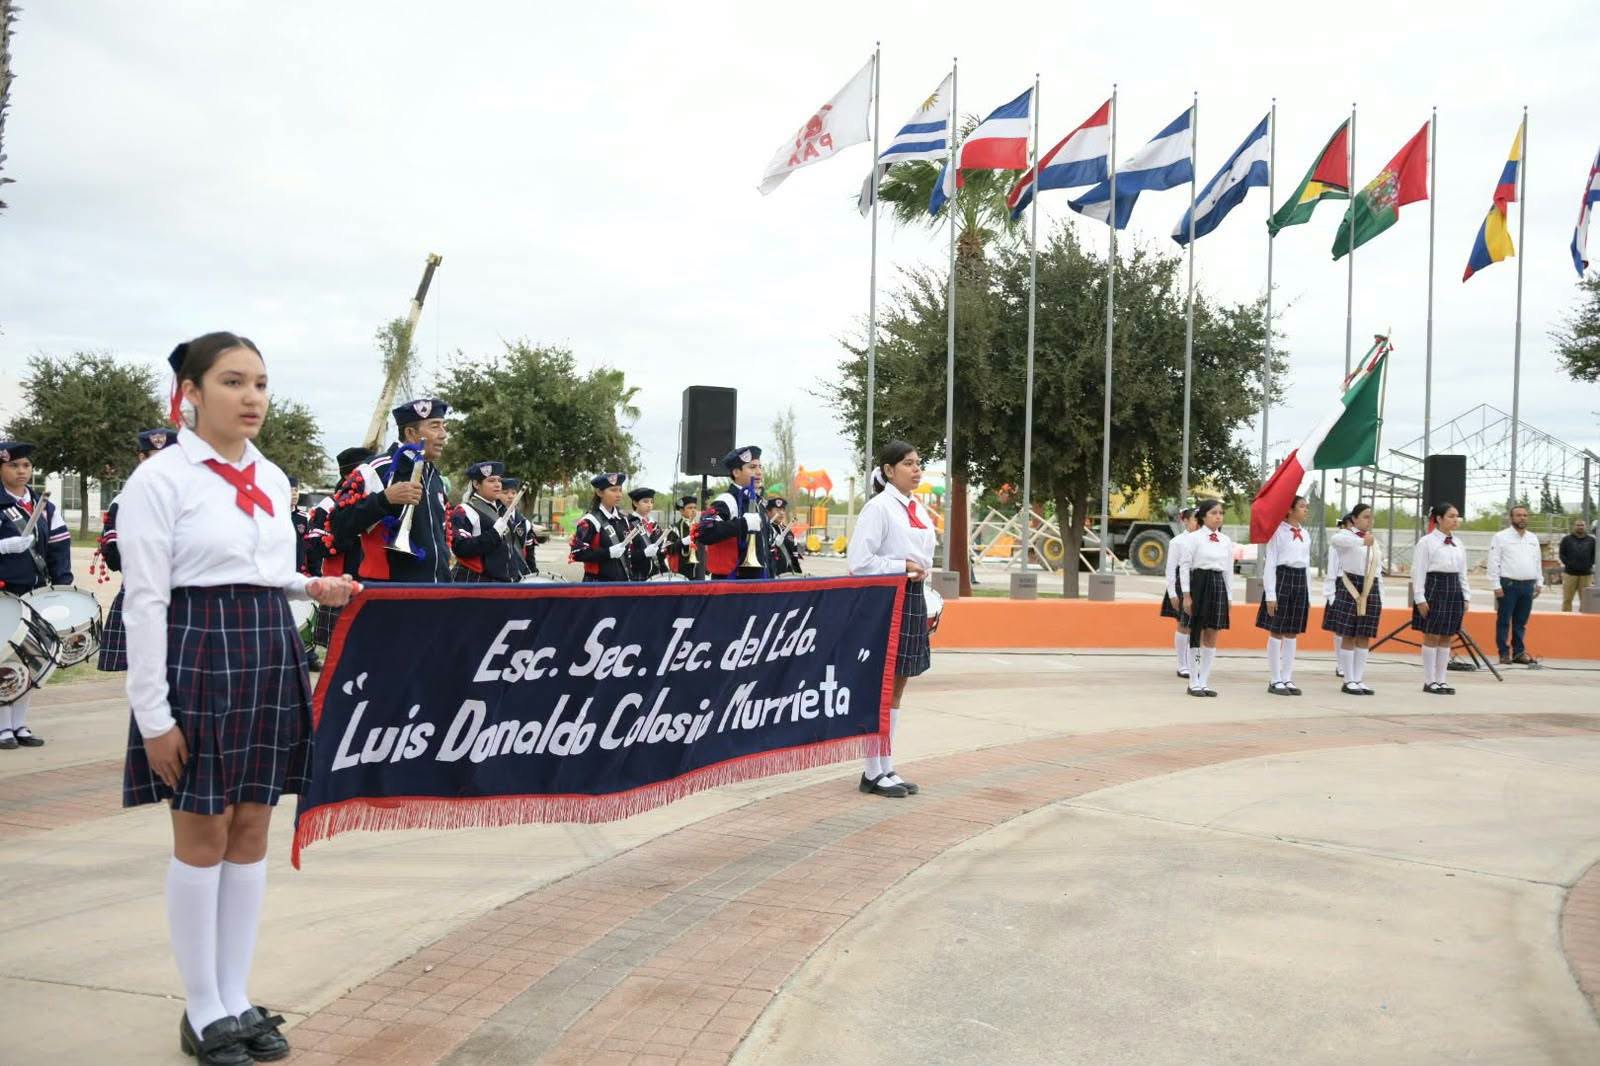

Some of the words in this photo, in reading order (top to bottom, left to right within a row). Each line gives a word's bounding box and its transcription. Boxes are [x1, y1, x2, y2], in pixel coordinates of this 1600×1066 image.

[473, 619, 559, 683] Esc.
[568, 617, 647, 681] Sec.
[656, 617, 712, 677] Tec.
[719, 612, 781, 671] del
[765, 606, 817, 663] Edo.
[434, 694, 597, 764] Donaldo
[599, 687, 715, 750] Colosio
